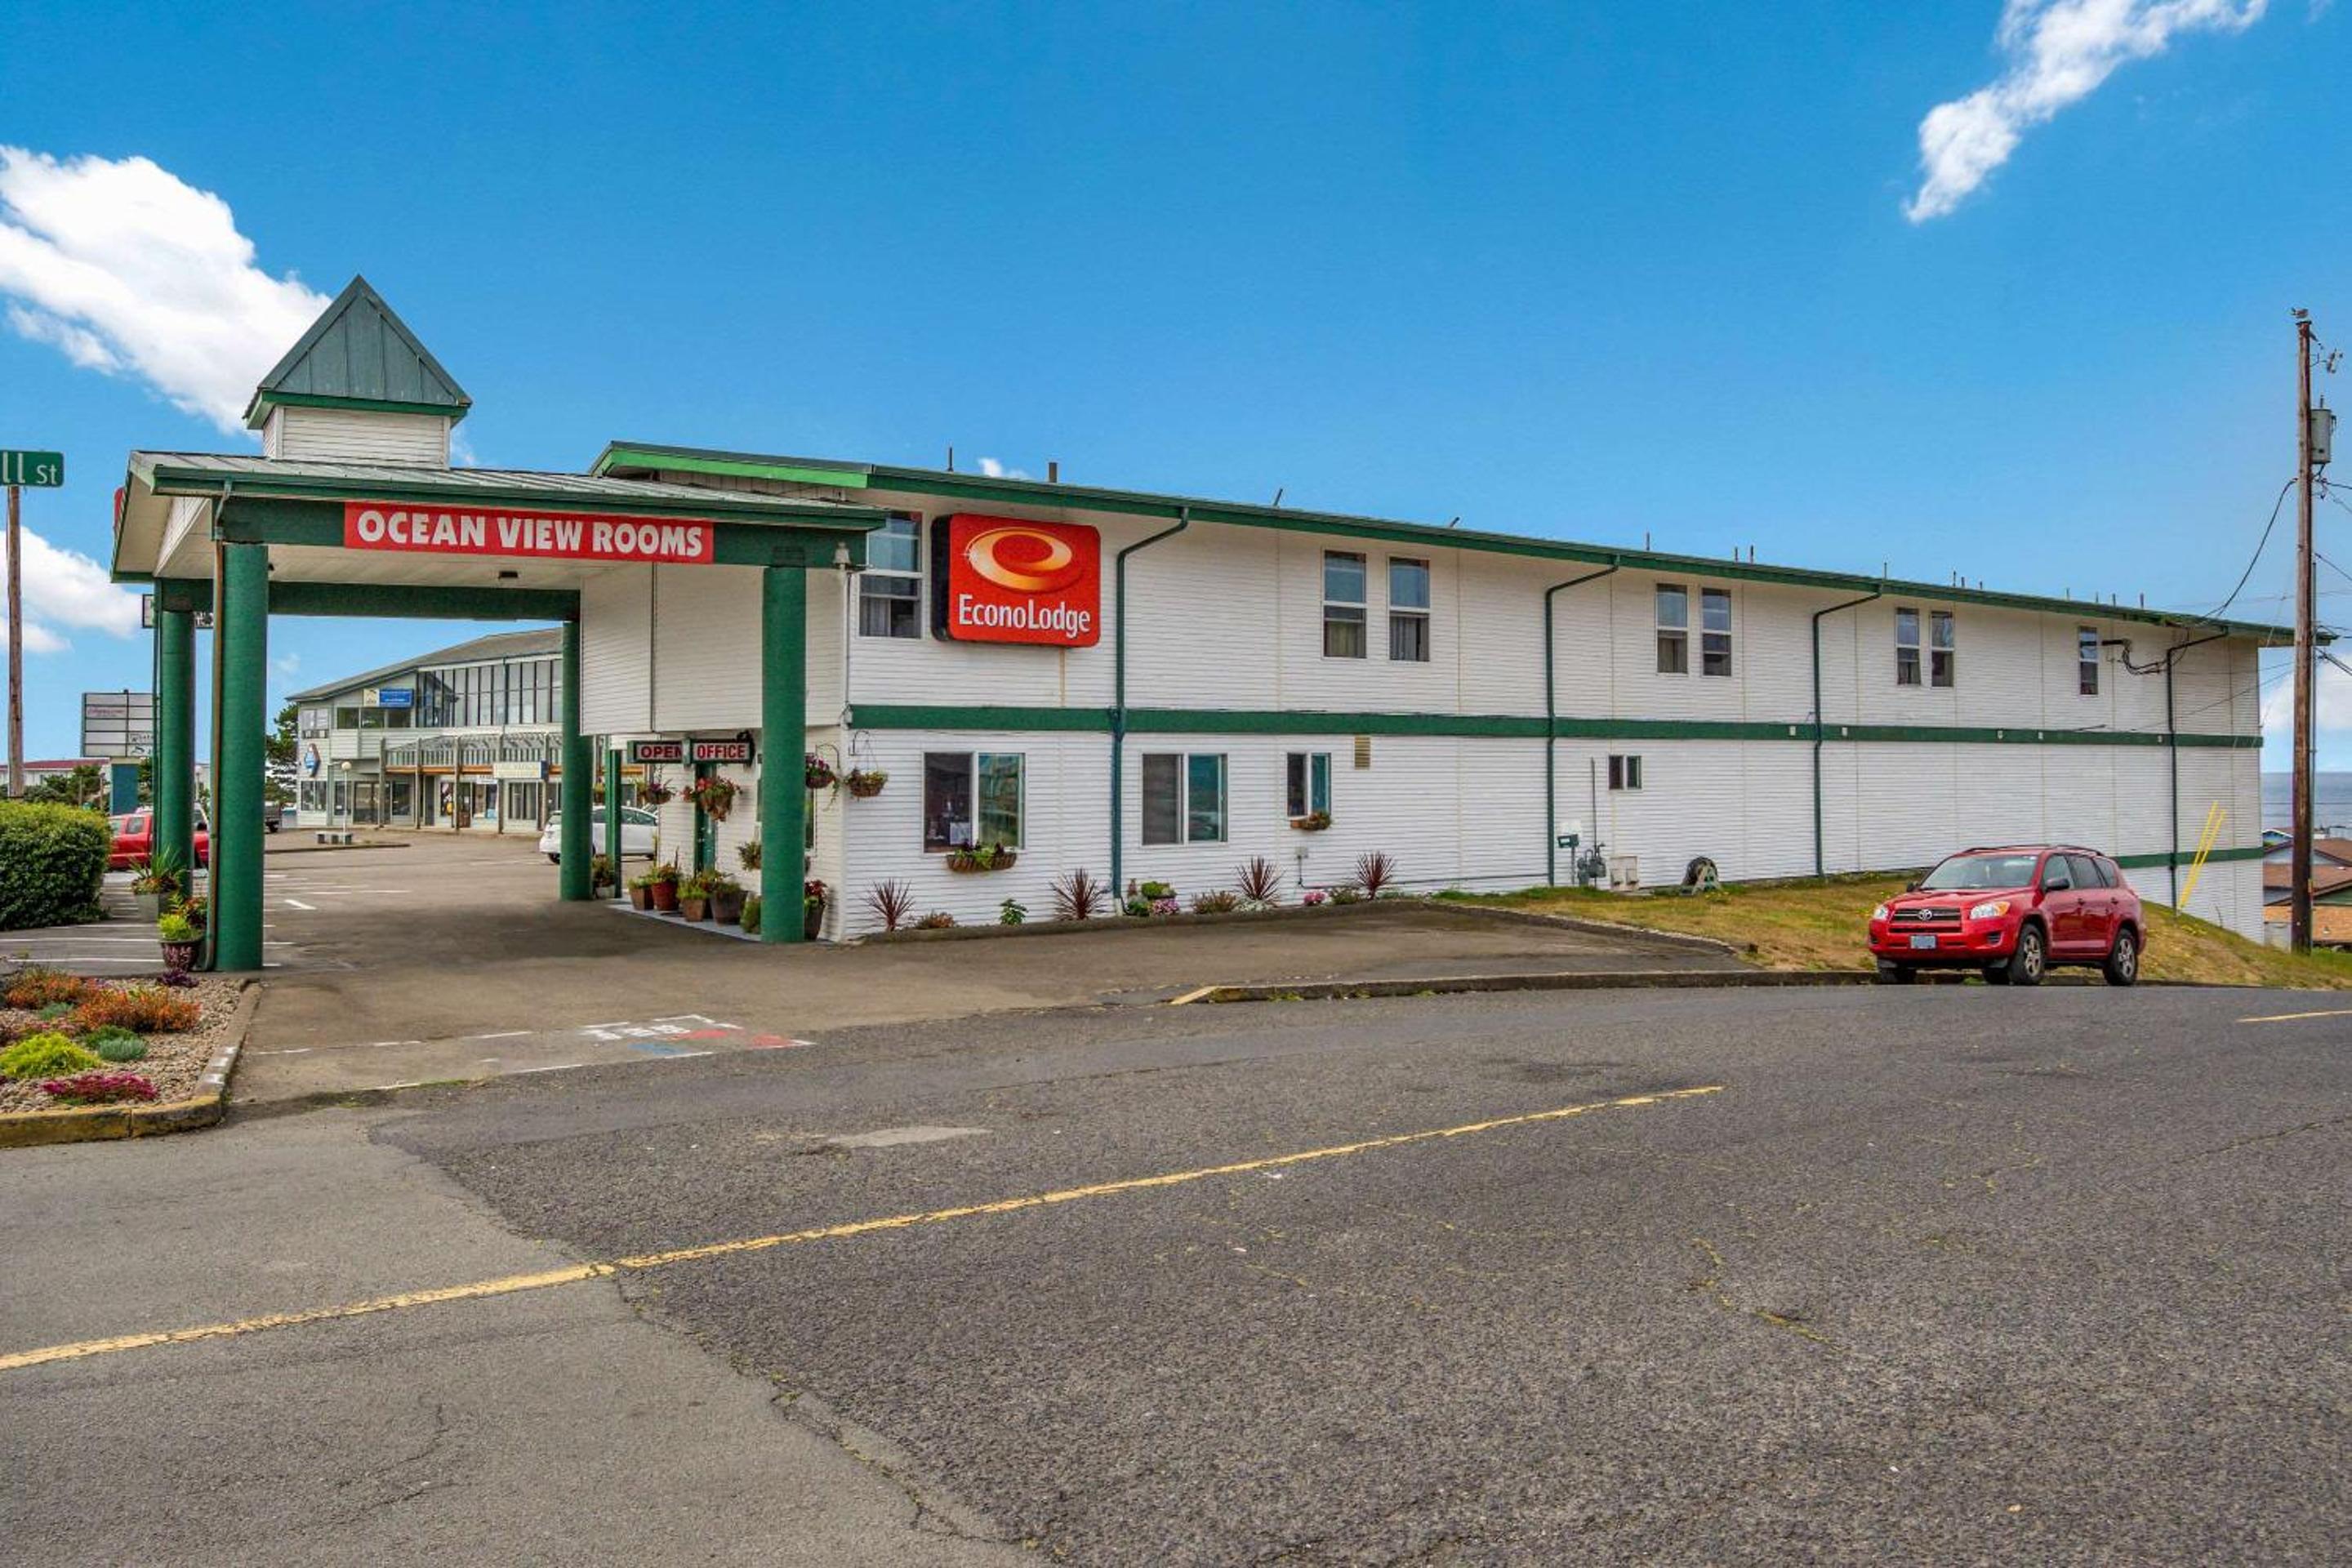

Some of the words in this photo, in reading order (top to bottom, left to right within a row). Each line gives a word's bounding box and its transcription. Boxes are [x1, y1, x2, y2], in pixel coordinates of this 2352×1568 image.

[36, 463, 58, 485] St
[357, 510, 487, 547] OCEAN
[496, 516, 583, 552] VIEW
[592, 523, 703, 557] ROOMS
[697, 744, 746, 760] OFFICE
